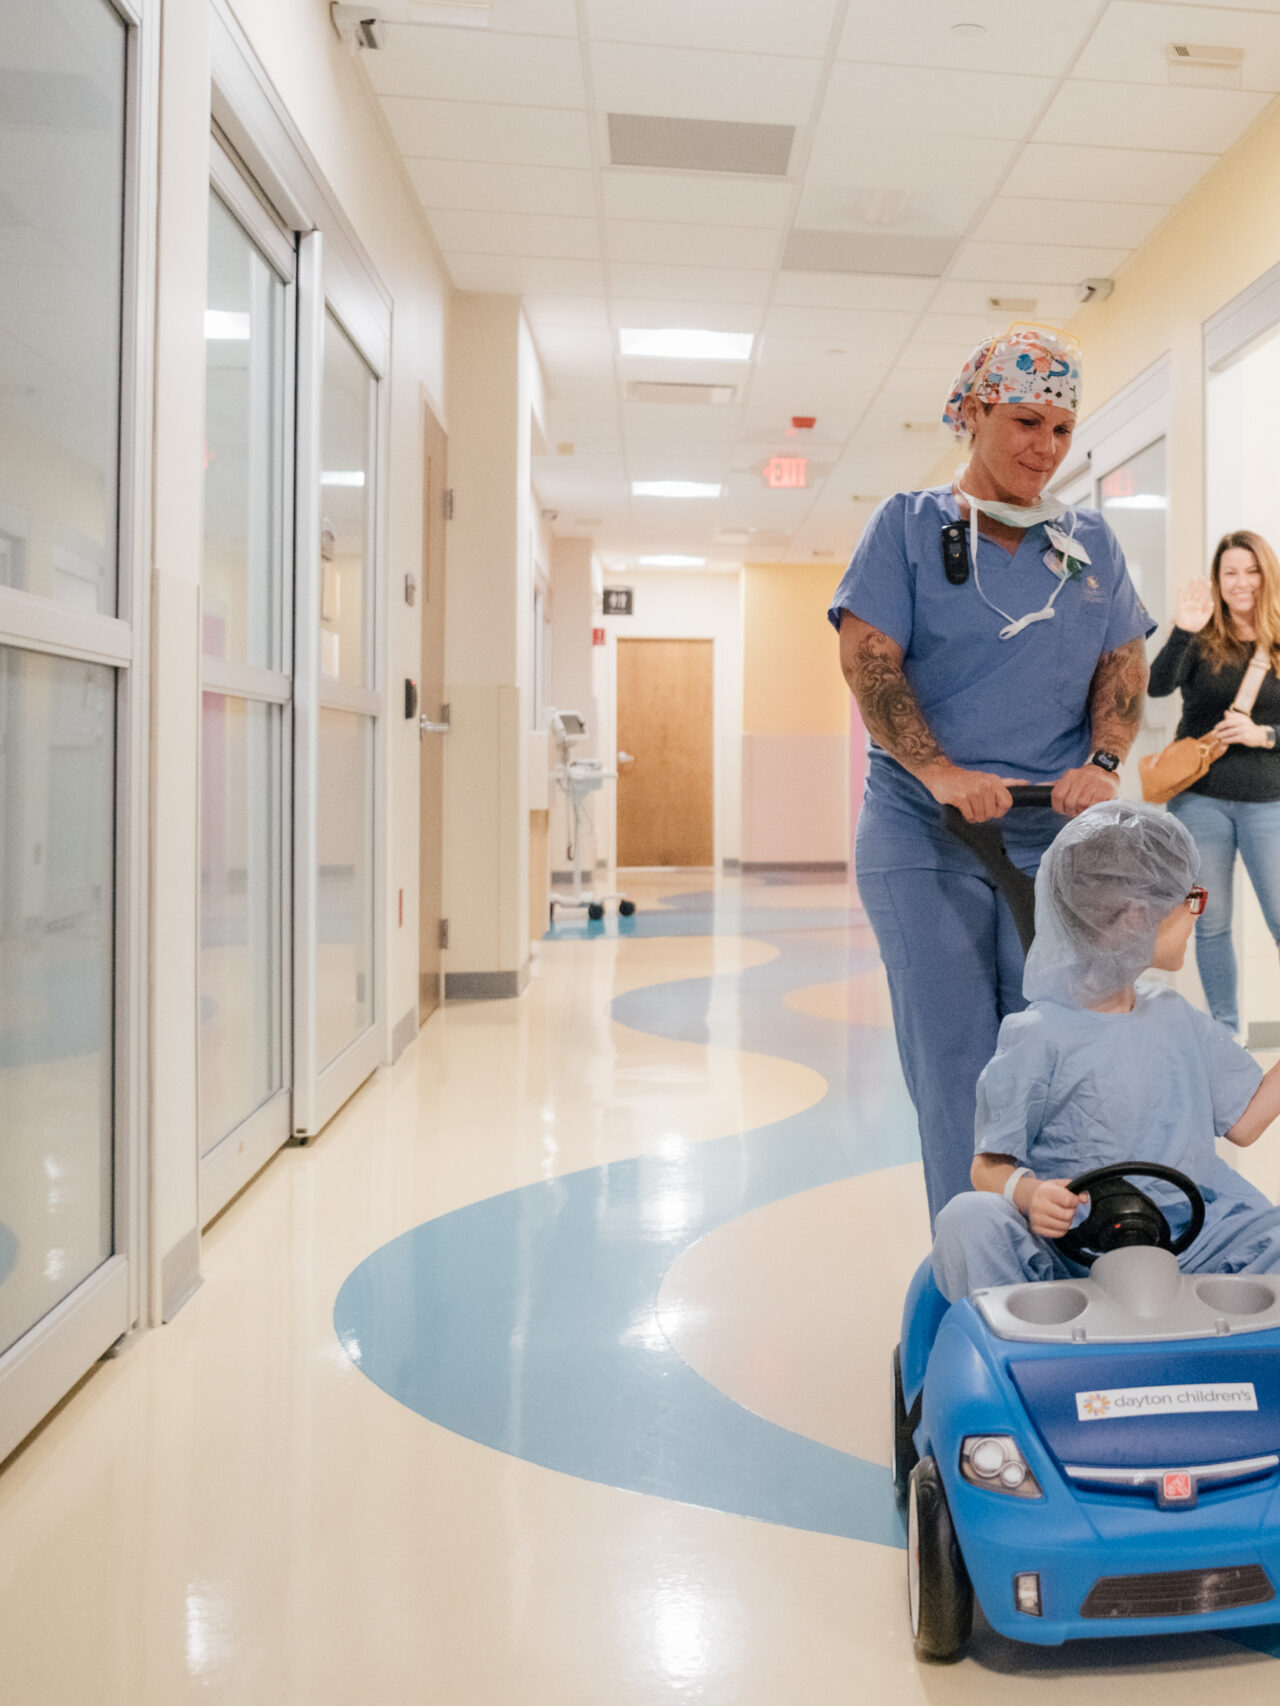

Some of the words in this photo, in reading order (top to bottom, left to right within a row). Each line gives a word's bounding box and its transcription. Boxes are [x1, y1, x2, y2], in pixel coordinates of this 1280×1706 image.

[768, 457, 808, 488] EXIT
[1114, 1393, 1172, 1408] dayton
[1176, 1389, 1251, 1404] children's
